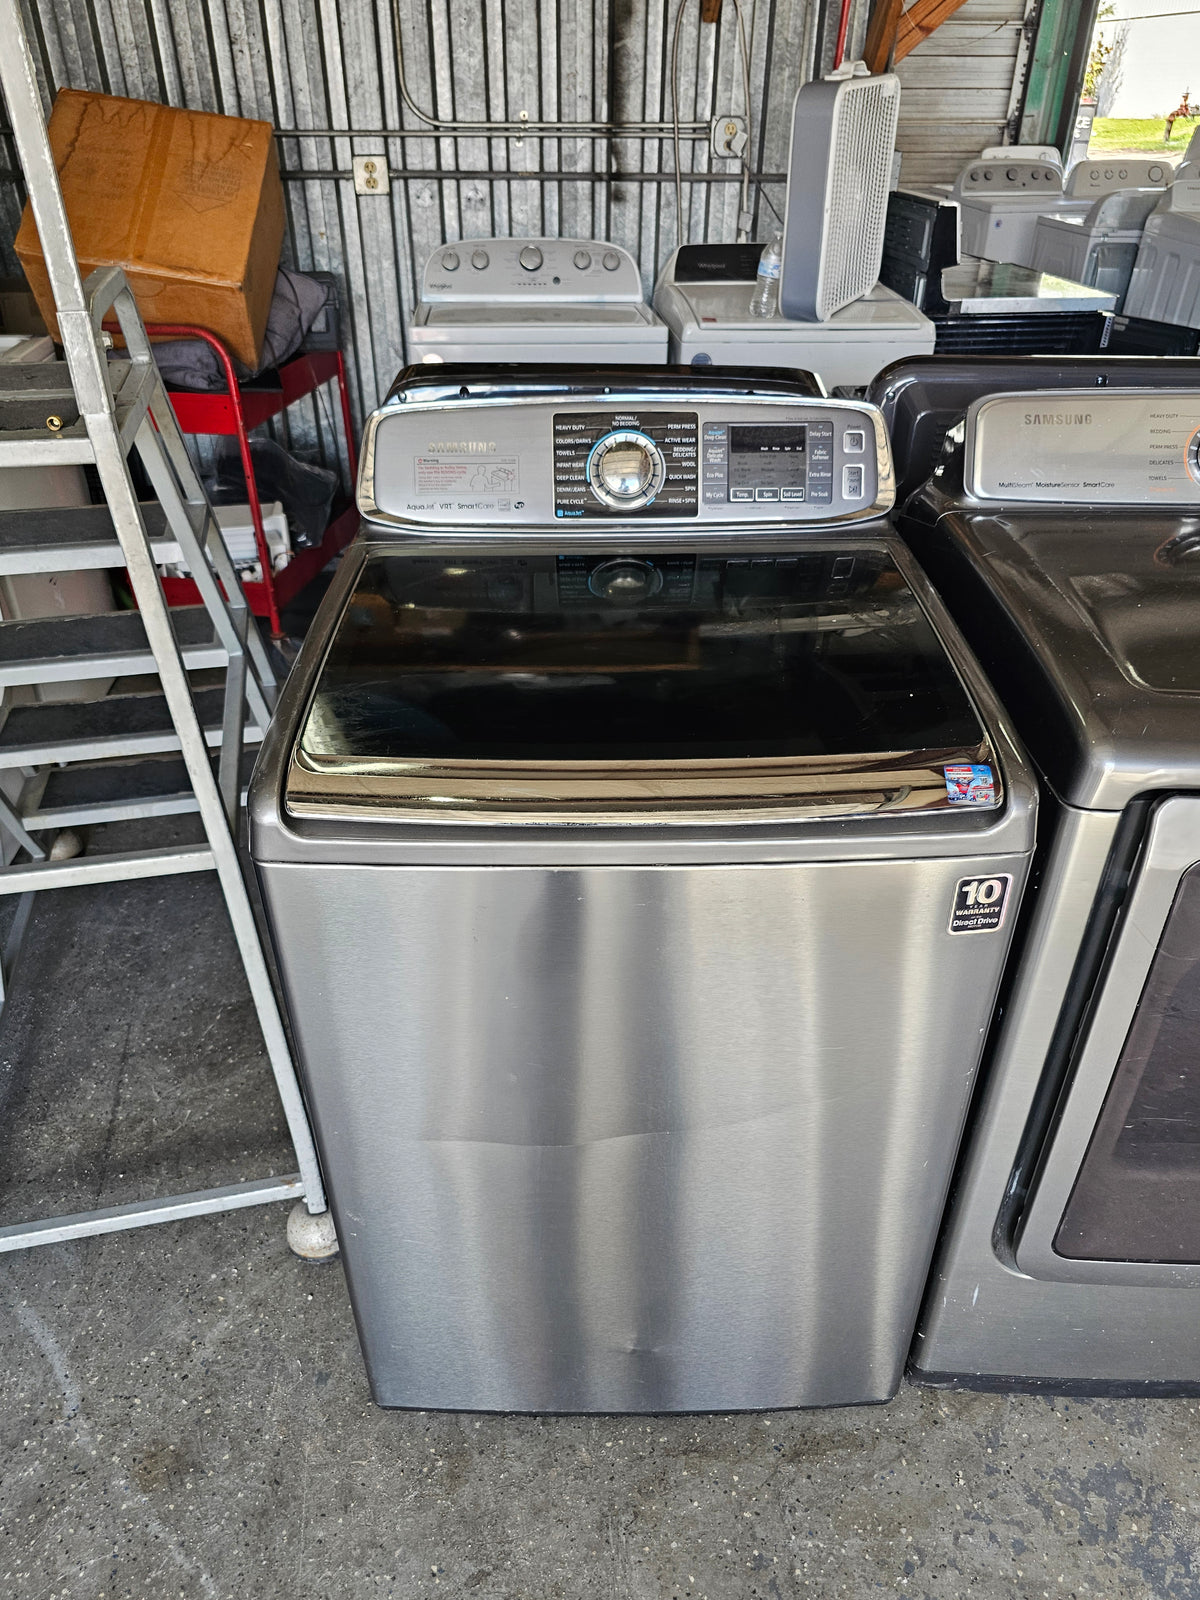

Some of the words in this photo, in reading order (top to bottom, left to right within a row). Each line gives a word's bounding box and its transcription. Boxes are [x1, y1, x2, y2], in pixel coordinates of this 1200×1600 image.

[1024, 414, 1093, 425] SAMSUNG
[427, 441, 497, 454] SAMSUNG
[457, 502, 495, 510] SmartCare
[961, 879, 1002, 906] 10
[955, 906, 1000, 916] WARRANTY
[952, 918, 978, 927] Direct
